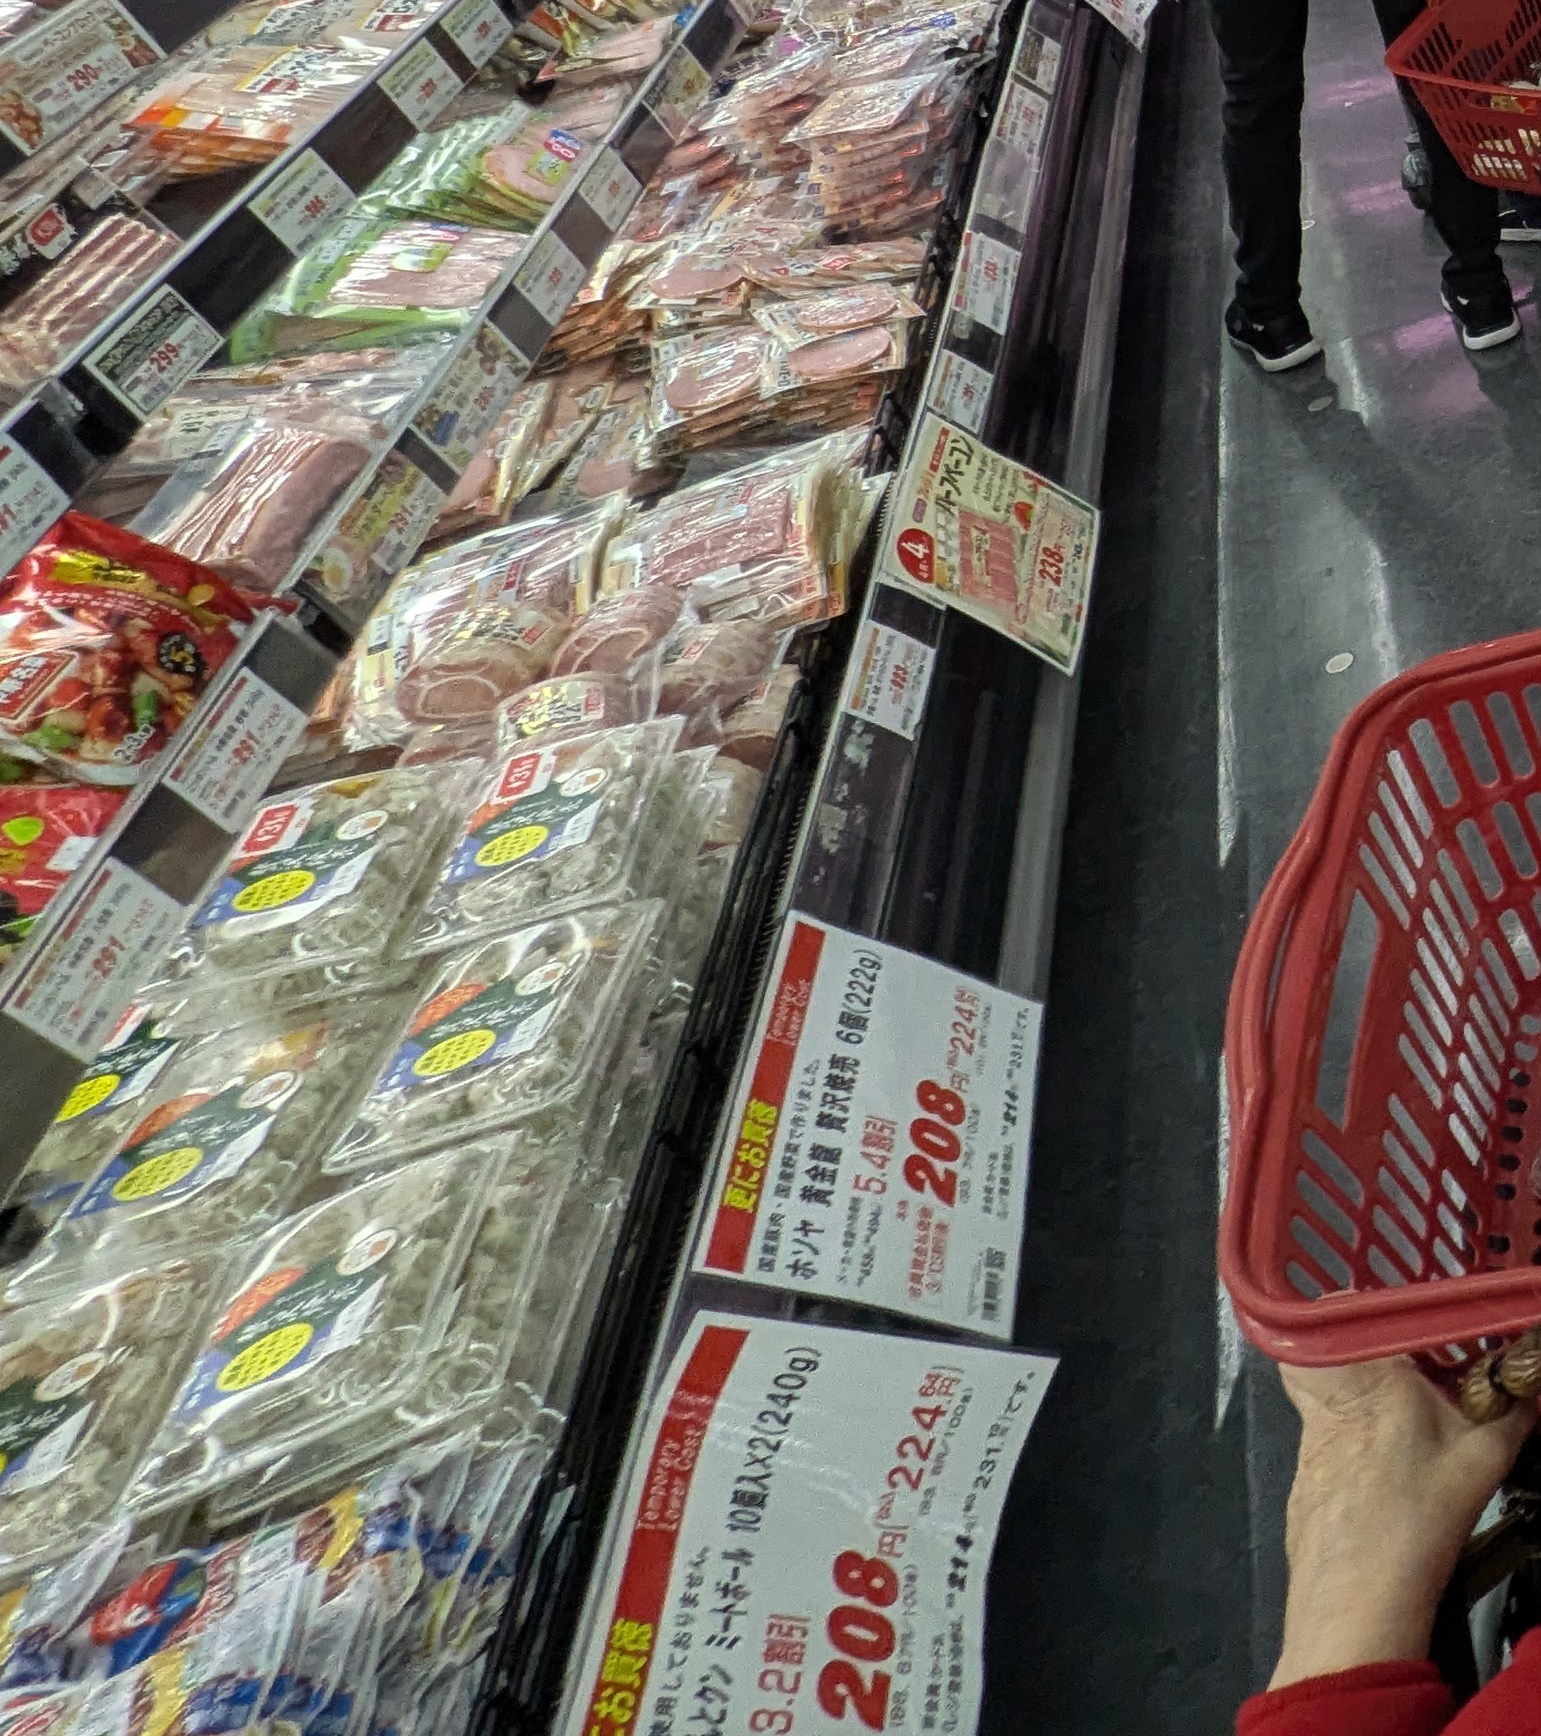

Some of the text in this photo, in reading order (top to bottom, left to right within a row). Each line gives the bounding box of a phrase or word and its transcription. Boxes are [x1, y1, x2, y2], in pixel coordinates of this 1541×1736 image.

[851, 1114, 899, 1196] 5.4割引
[902, 1079, 966, 1208] 208
[786, 1219, 826, 1281] ホソヤ
[704, 1547, 756, 1650] ミートボール
[816, 1549, 900, 1731] 208
